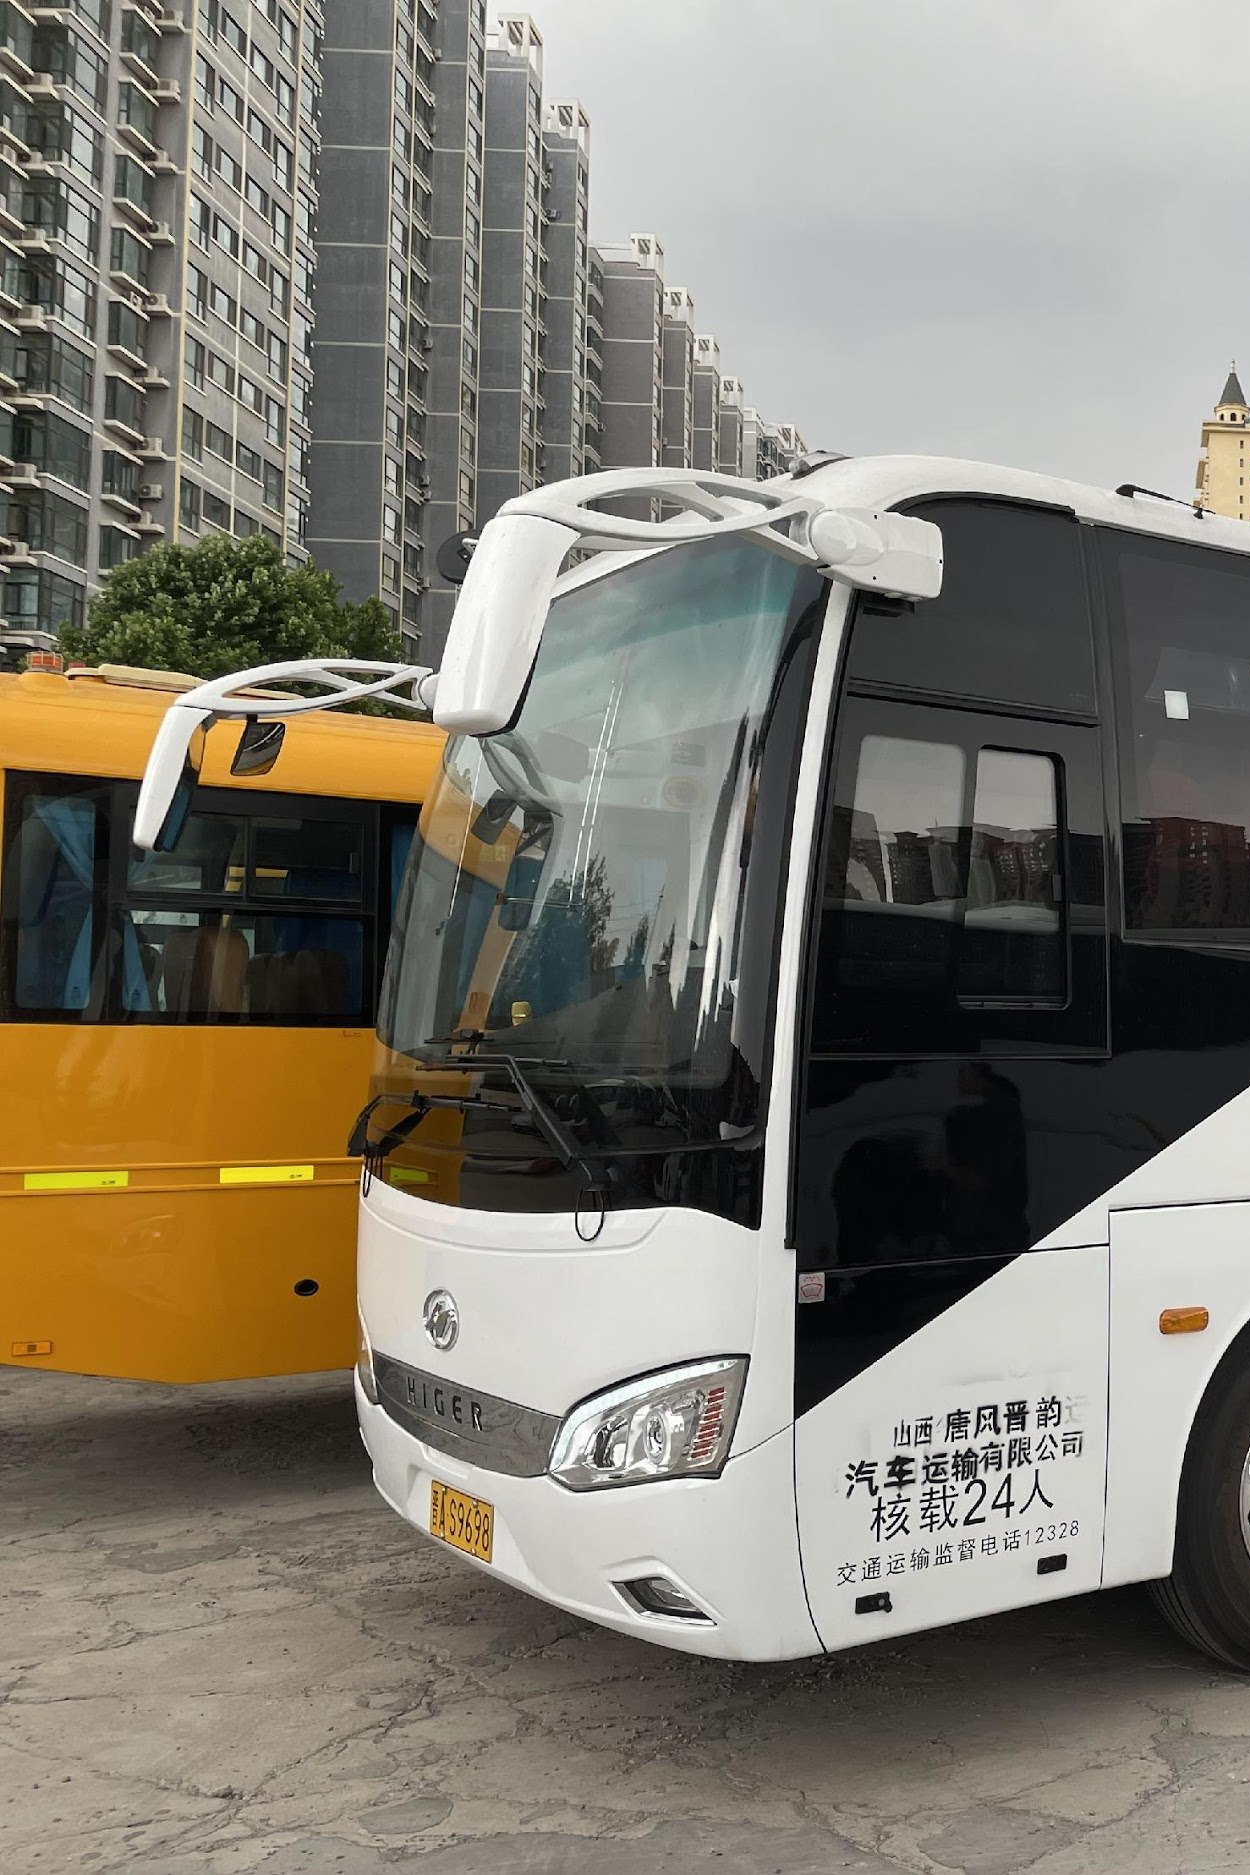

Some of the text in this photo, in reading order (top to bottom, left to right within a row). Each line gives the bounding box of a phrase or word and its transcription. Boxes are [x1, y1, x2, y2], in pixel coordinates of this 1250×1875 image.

[406, 1375, 483, 1432] HIGER
[844, 1430, 1085, 1499] 汽车运输有限公司
[869, 1468, 1055, 1543] 核载24人
[836, 1519, 1080, 1587] 交通运输监督电话12328
